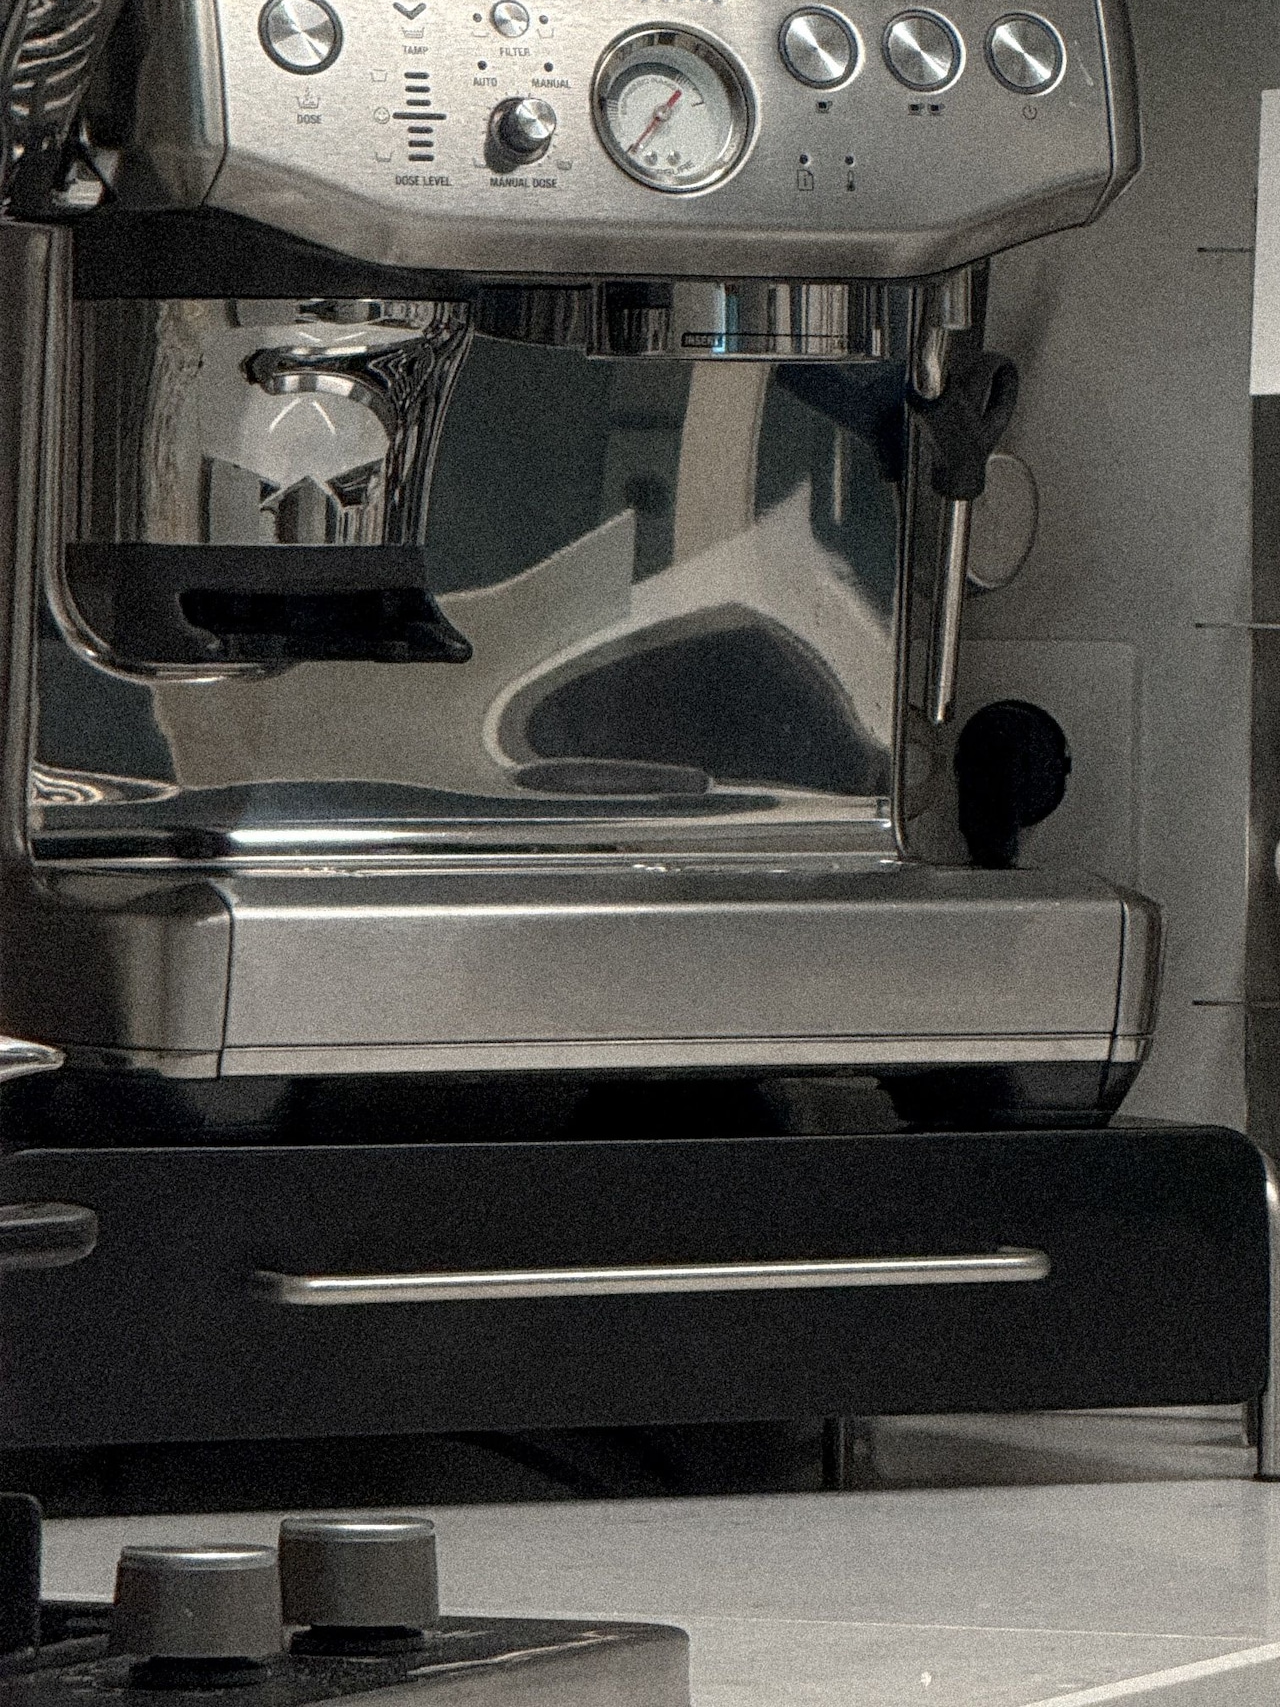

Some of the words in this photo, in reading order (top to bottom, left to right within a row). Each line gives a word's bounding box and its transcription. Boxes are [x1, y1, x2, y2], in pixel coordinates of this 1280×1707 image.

[403, 45, 430, 56] TAMP
[499, 47, 531, 57] FILTER
[473, 77, 498, 87] AUTO
[532, 78, 572, 89] MANUAL
[296, 114, 322, 125] DOSE
[395, 175, 421, 186] DOSE
[424, 176, 452, 187] LEVEL
[490, 177, 529, 188] MANUAL
[532, 178, 557, 189] DOSE
